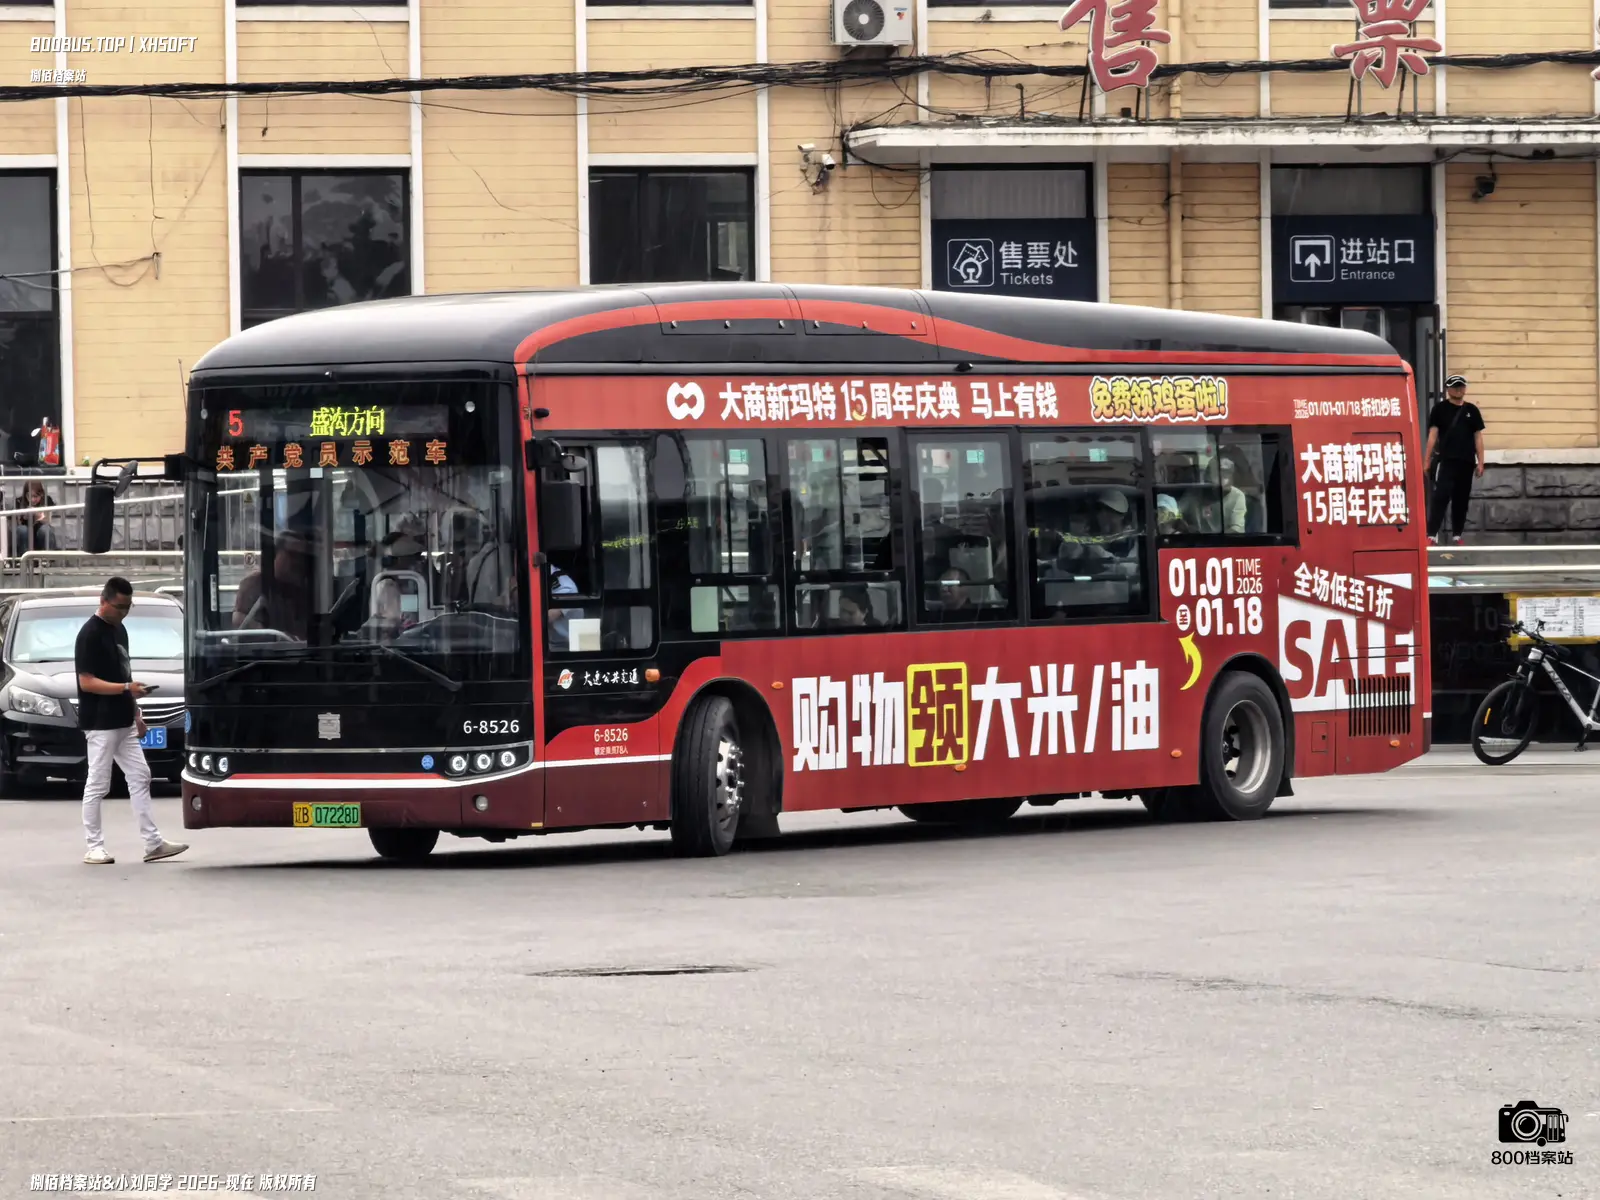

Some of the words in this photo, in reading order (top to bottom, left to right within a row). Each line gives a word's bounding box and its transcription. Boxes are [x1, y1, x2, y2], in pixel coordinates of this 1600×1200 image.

[999, 240, 1078, 269] 售票处
[1340, 237, 1416, 265] 进站口
[1000, 272, 1054, 286] Tickets
[1340, 267, 1395, 281] Entrance
[970, 381, 1059, 420] 马上有钱
[229, 410, 243, 436] 5
[216, 439, 447, 470] 共产党员示范车
[1300, 442, 1406, 484] 大商新玛特
[1302, 488, 1410, 526] 15周年庆典
[1168, 557, 1235, 597] 01.01
[1236, 558, 1261, 576] TIME
[1236, 577, 1263, 595] 2026
[1293, 562, 1394, 620] 全场低至1折
[1195, 596, 1263, 637] 01.18
[1284, 616, 1411, 699] SALE
[463, 719, 520, 734] 6-8526
[594, 728, 628, 742] 6-8526
